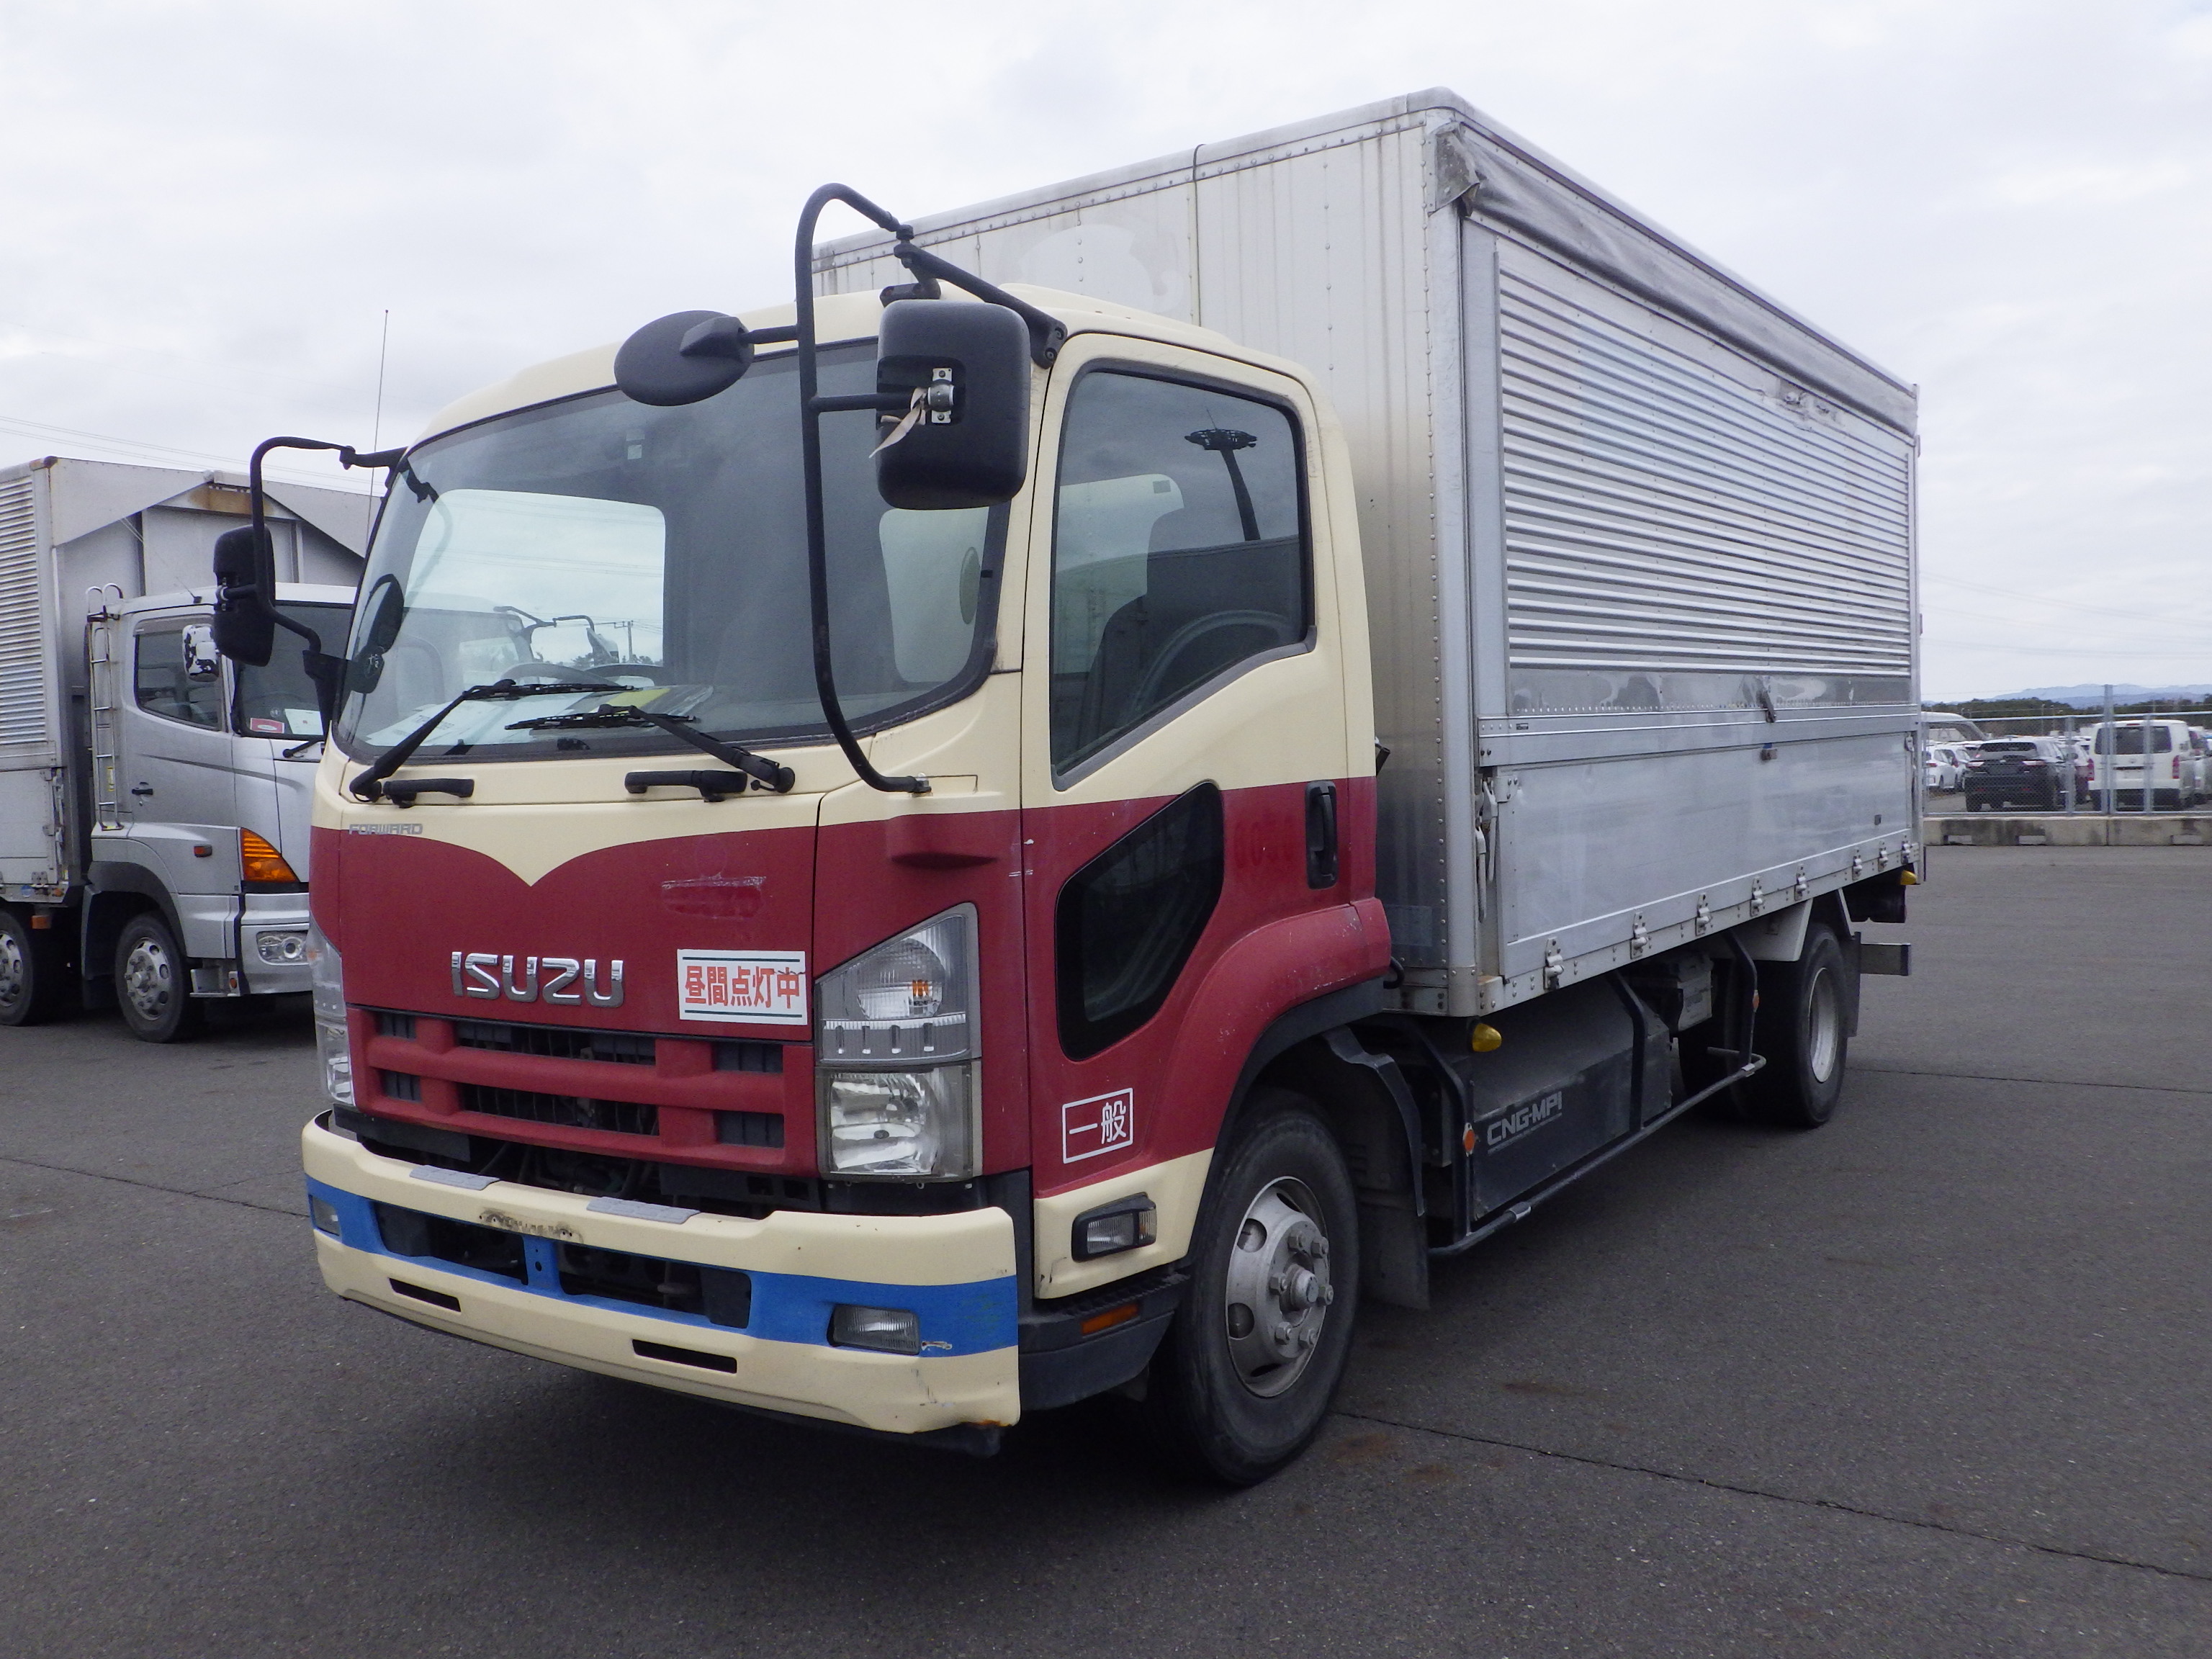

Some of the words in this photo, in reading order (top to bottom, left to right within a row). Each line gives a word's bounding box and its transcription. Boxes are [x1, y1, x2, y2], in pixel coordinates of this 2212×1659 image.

[349, 823, 423, 835] FORWARD
[451, 951, 624, 1008] ISUZU
[685, 965, 801, 1009] 昼間点灯中
[1069, 1100, 1127, 1144] 一般
